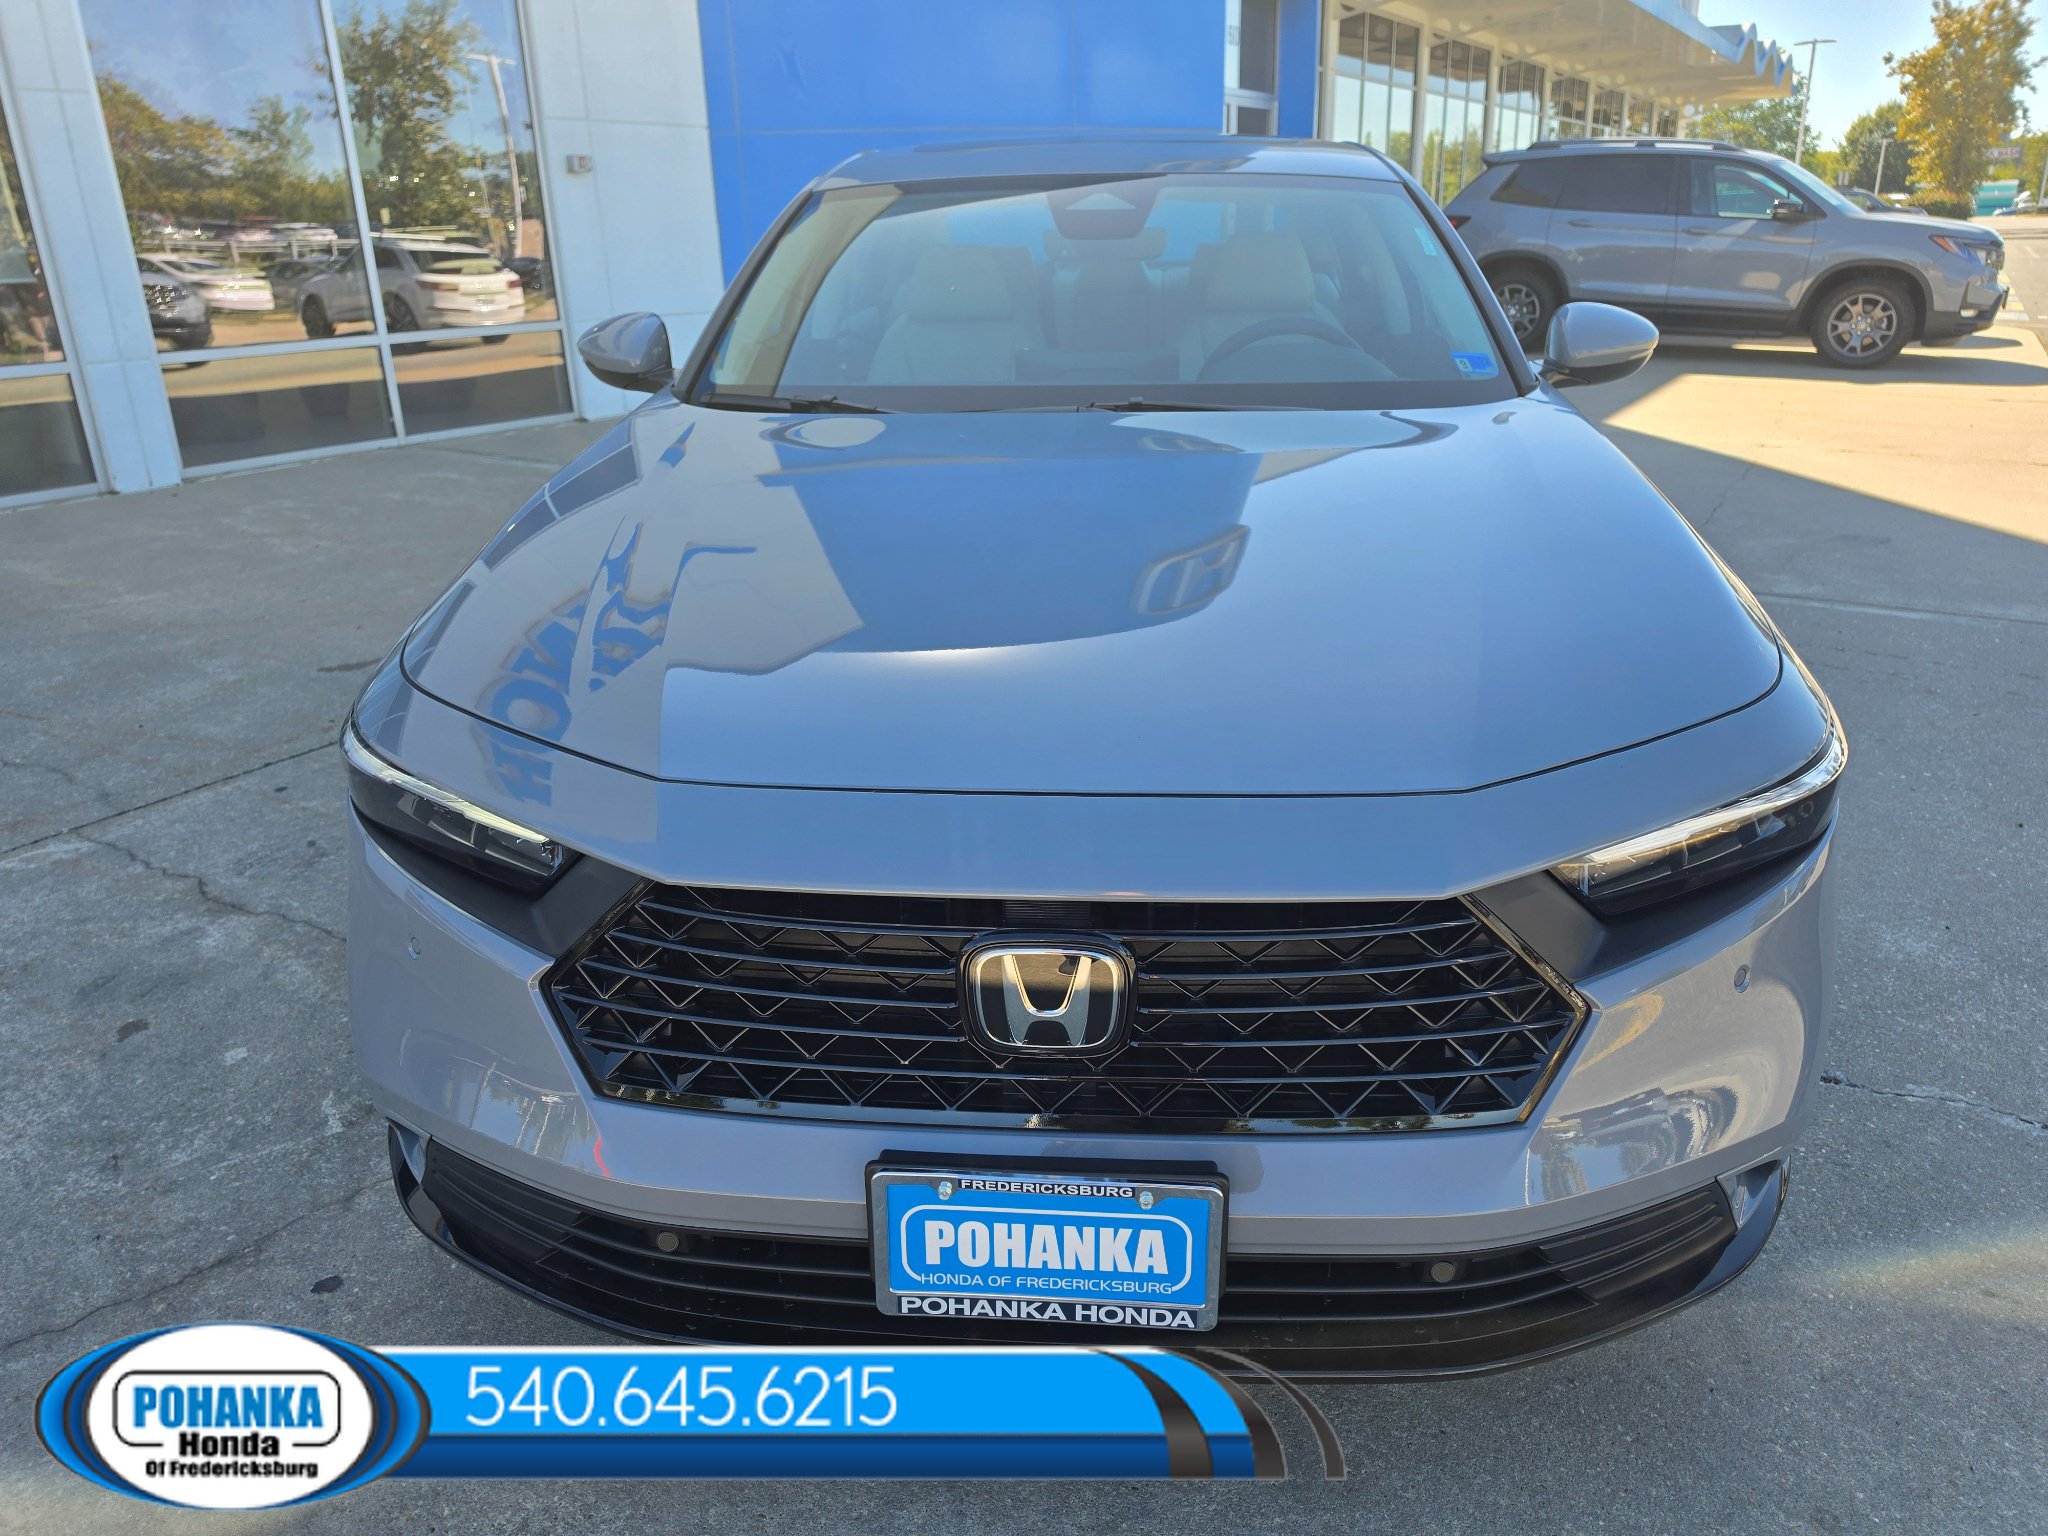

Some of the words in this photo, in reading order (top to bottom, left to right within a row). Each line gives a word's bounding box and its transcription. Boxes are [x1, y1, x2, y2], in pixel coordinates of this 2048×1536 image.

[961, 1179, 1133, 1198] FREDERICKSBURG
[924, 1220, 1169, 1275] POHANKA
[921, 1272, 984, 1287] HONDA
[988, 1275, 1012, 1288] OF
[1016, 1276, 1172, 1295] FREDERICKSBURG
[901, 1296, 1067, 1321] POHANKA
[1075, 1304, 1195, 1328] HONDA
